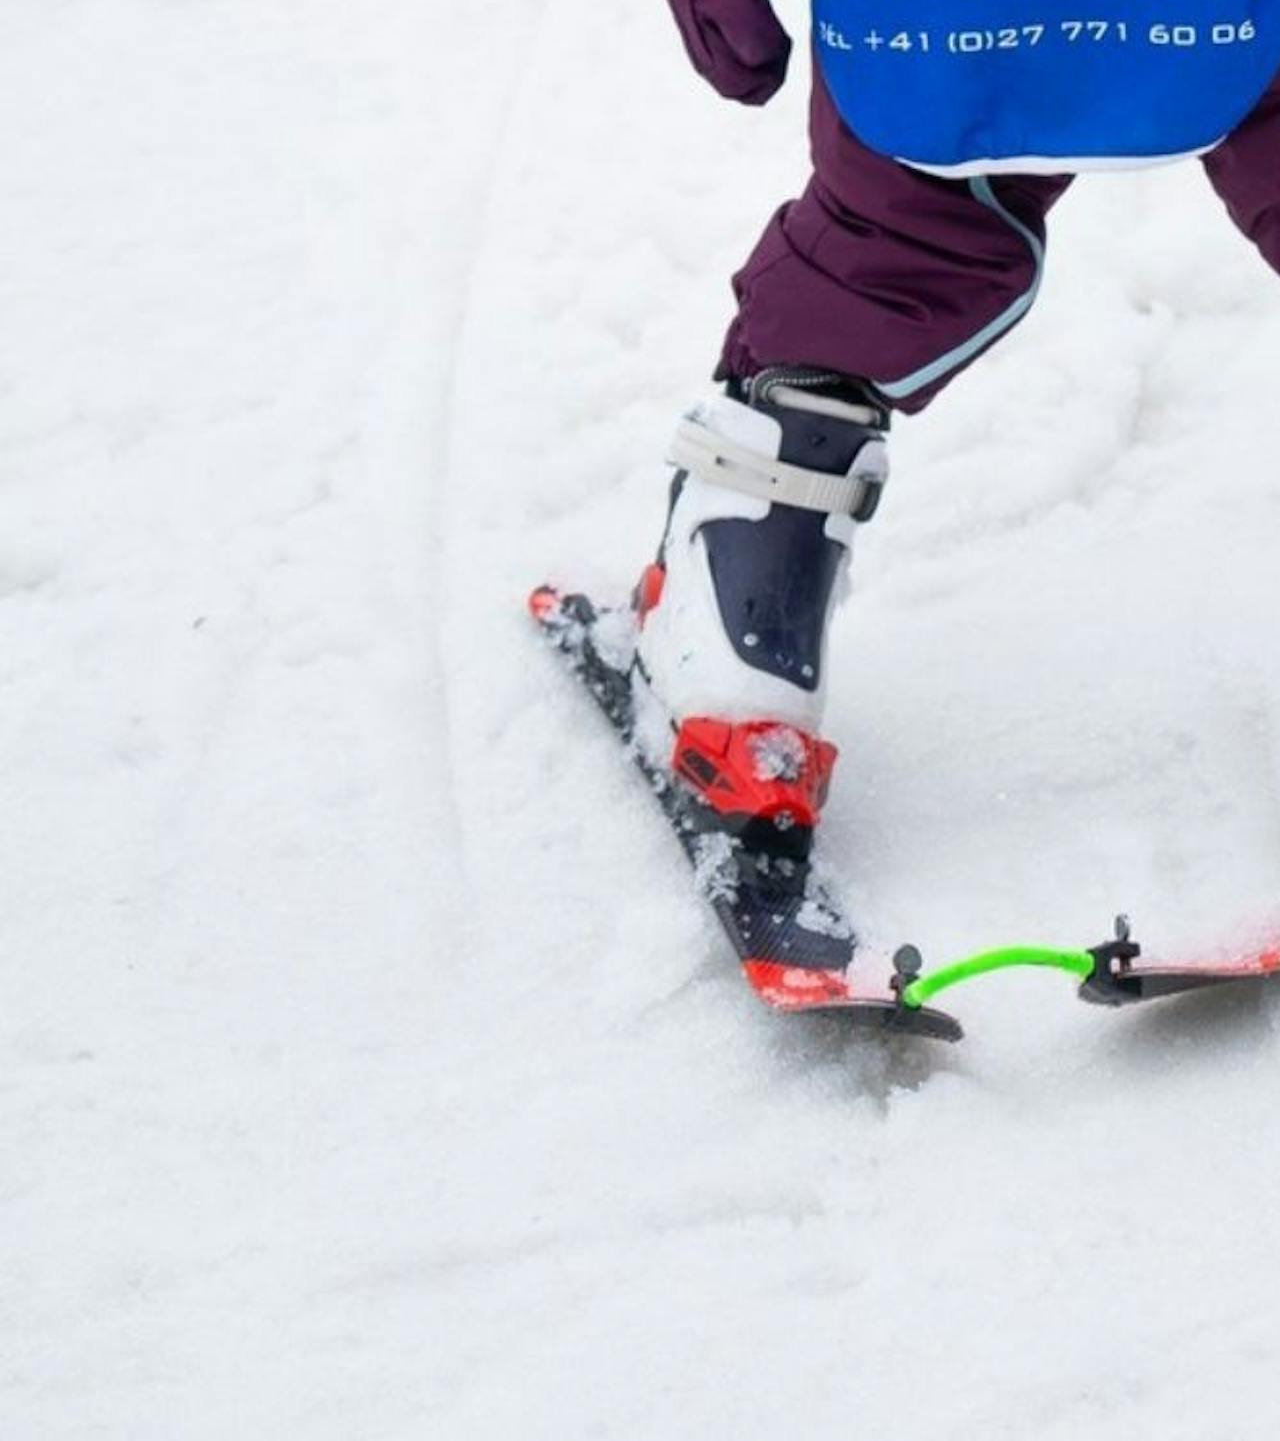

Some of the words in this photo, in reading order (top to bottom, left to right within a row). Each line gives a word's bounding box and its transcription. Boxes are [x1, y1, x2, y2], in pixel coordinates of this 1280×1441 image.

[865, 30, 929, 52] +41
[1061, 21, 1127, 41] 771
[1149, 24, 1197, 46] 60
[1212, 20, 1256, 44] 06
